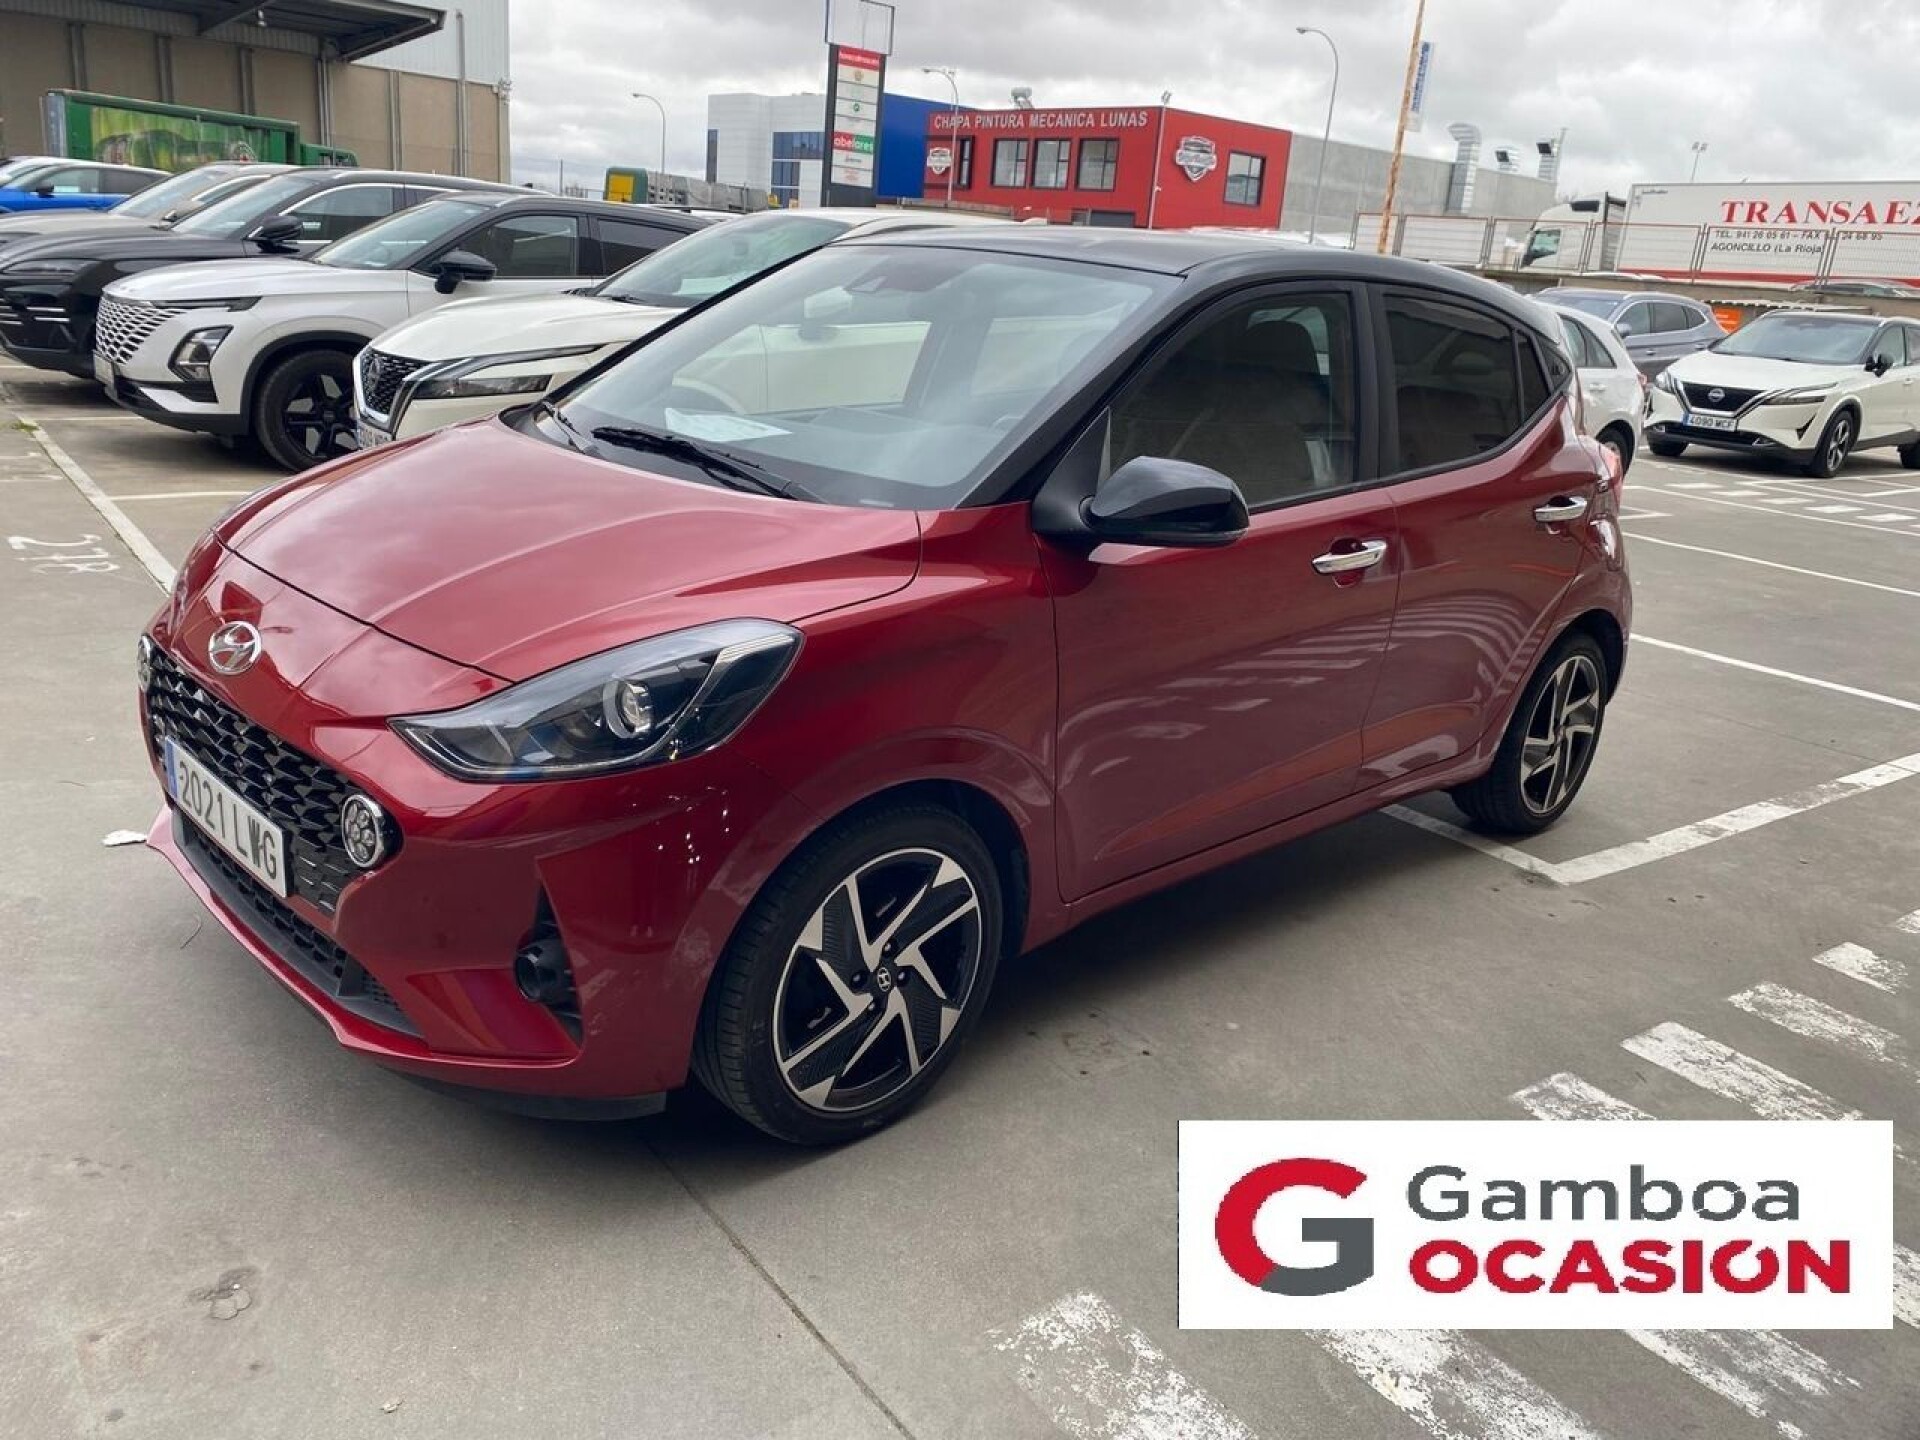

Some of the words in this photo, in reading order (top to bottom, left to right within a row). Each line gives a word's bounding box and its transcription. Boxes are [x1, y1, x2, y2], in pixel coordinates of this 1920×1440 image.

[934, 113, 970, 130] CHAPA
[975, 112, 1024, 128] PINTURA
[1029, 112, 1095, 128] MECANICA
[1100, 110, 1148, 127] LUNAS
[1711, 242, 1771, 253] AGONCILLO
[179, 761, 226, 839] 2021
[233, 803, 278, 880] LWG
